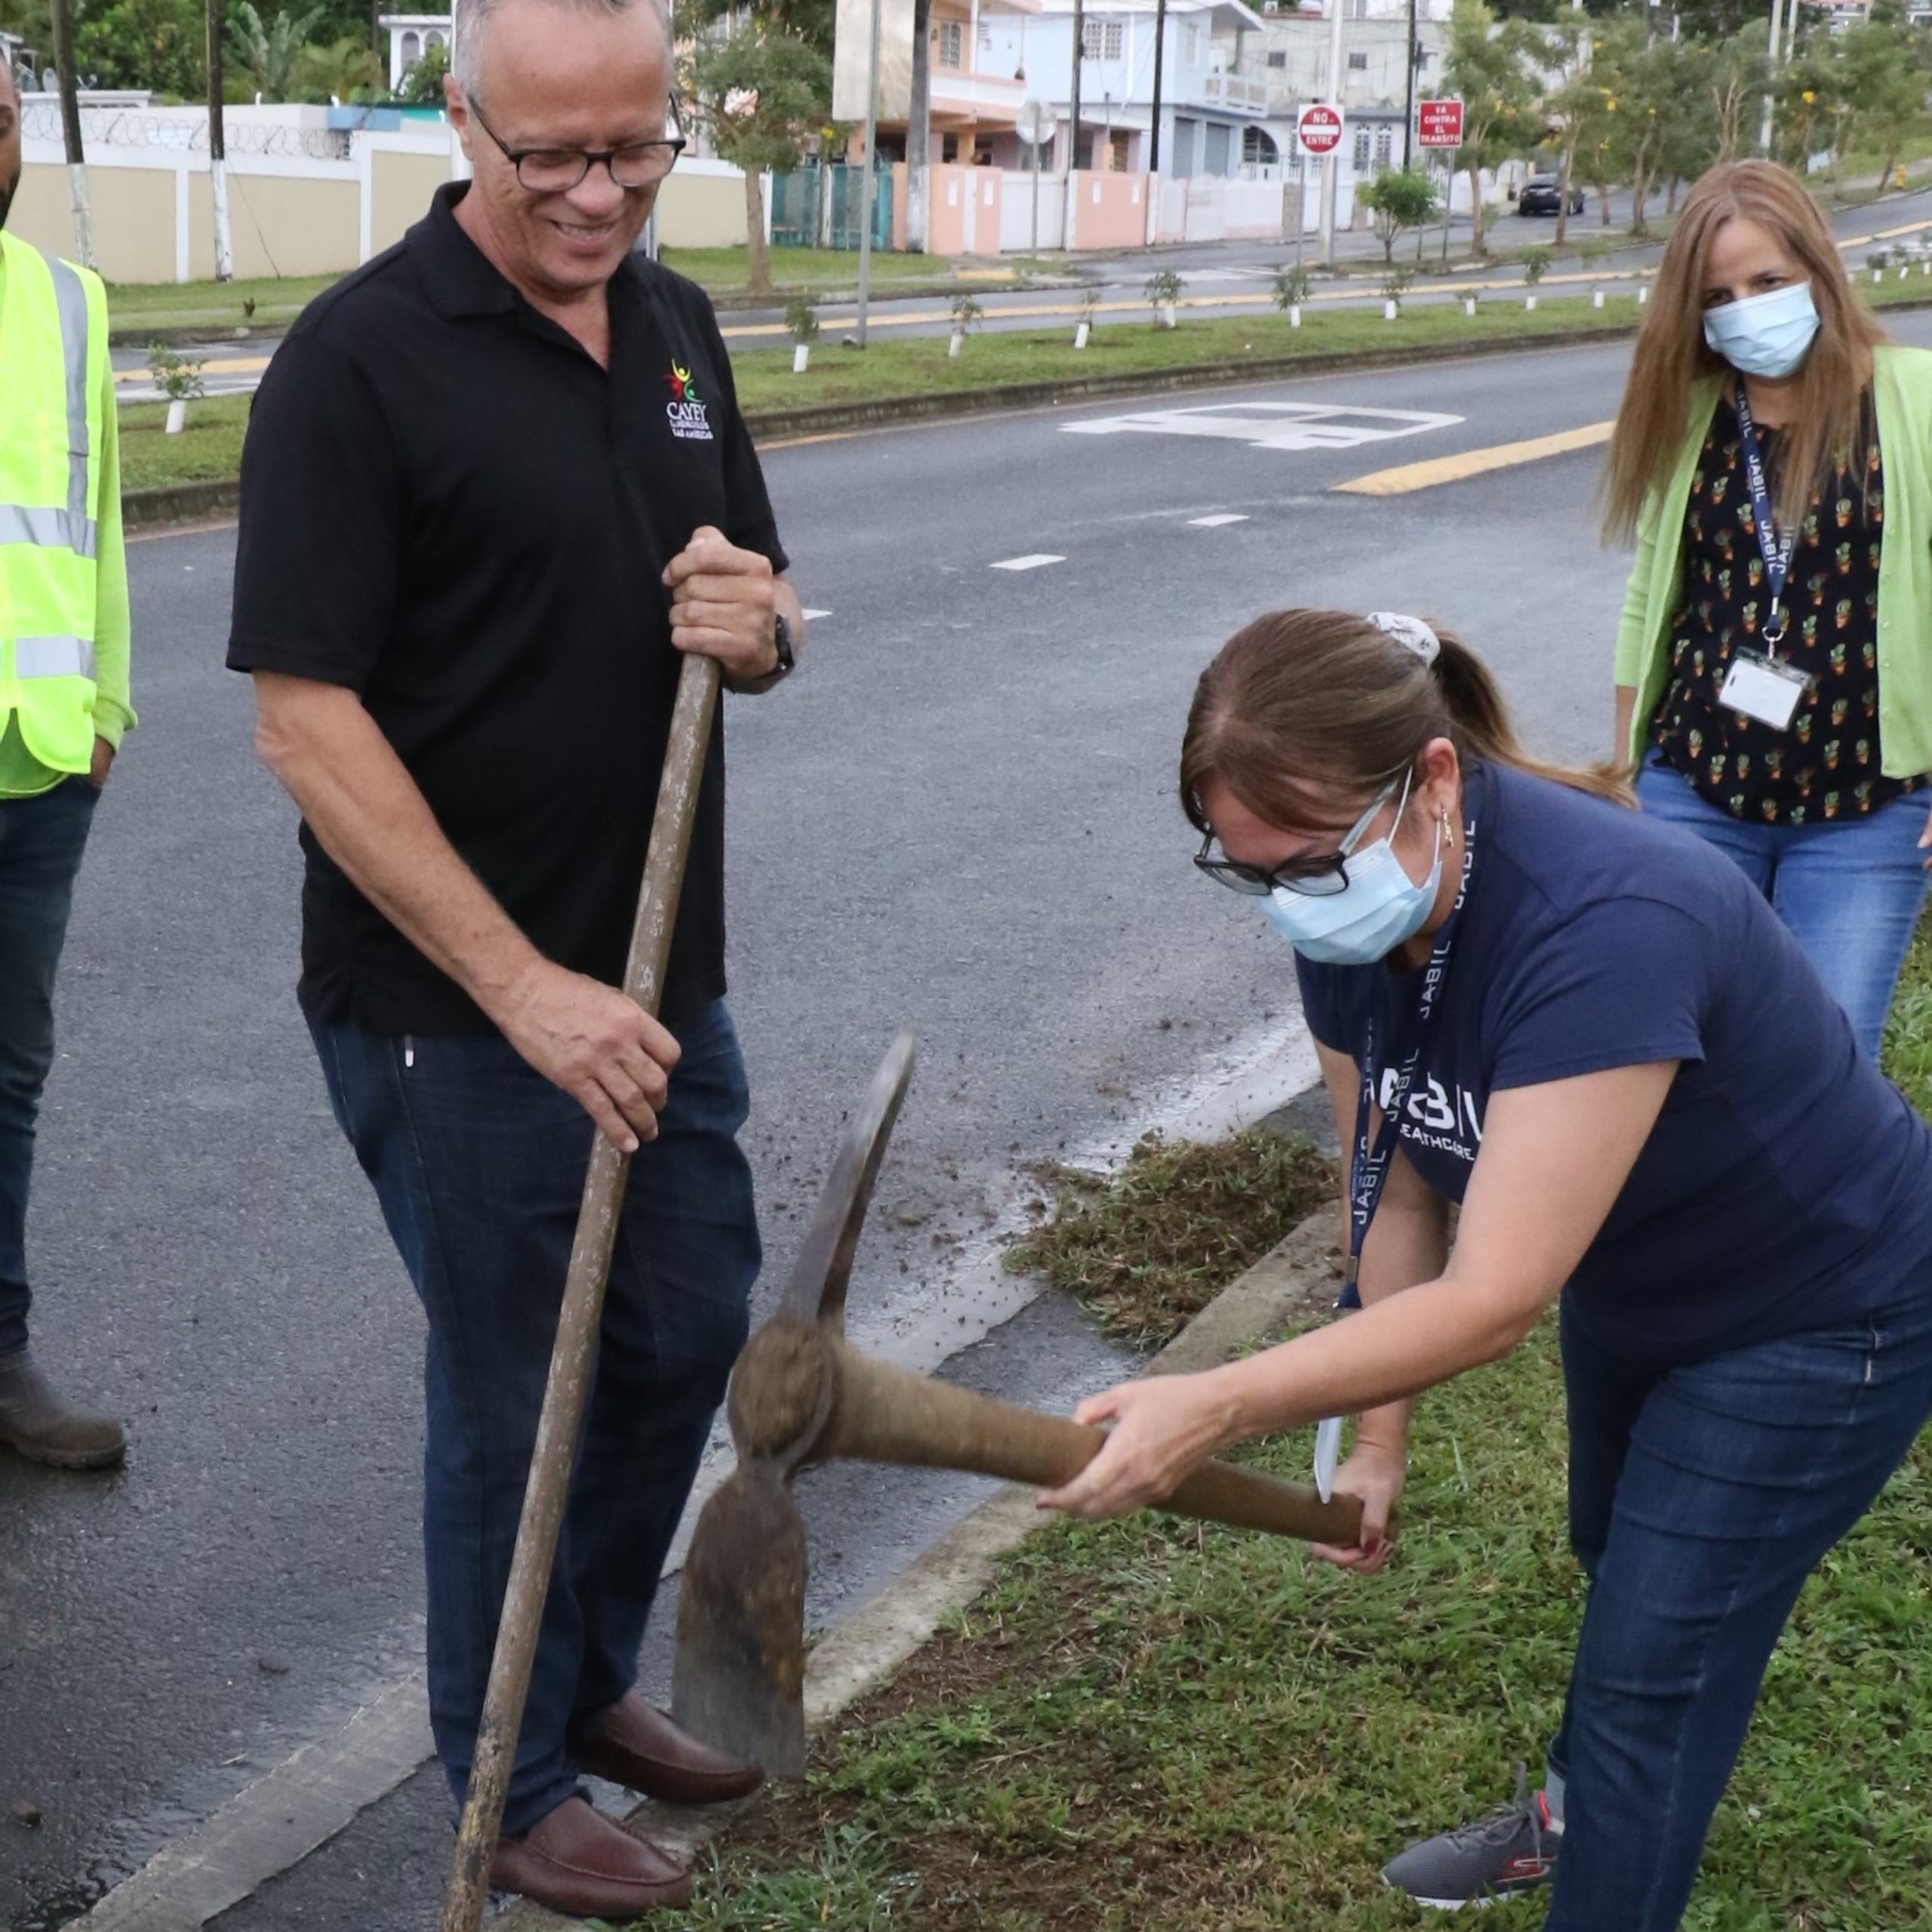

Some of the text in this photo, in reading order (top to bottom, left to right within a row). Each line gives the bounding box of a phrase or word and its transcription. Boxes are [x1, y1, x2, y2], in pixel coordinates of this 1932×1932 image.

[1312, 112, 1328, 123] NO
[1424, 115, 1457, 124] CONTRA
[1435, 106, 1447, 114] VA
[1420, 134, 1460, 143] TRANSITO
[1435, 125, 1444, 134] EL
[1306, 136, 1333, 145] ENTRE
[666, 401, 707, 422] CAYEY
[1737, 392, 1752, 438] JABIL
[1749, 454, 1766, 503] JABIL
[1760, 520, 1777, 574] JABIL
[1420, 940, 1451, 1020] JABIL
[1386, 1048, 1420, 1123] JABIL
[1352, 1149, 1386, 1225] JABIL
